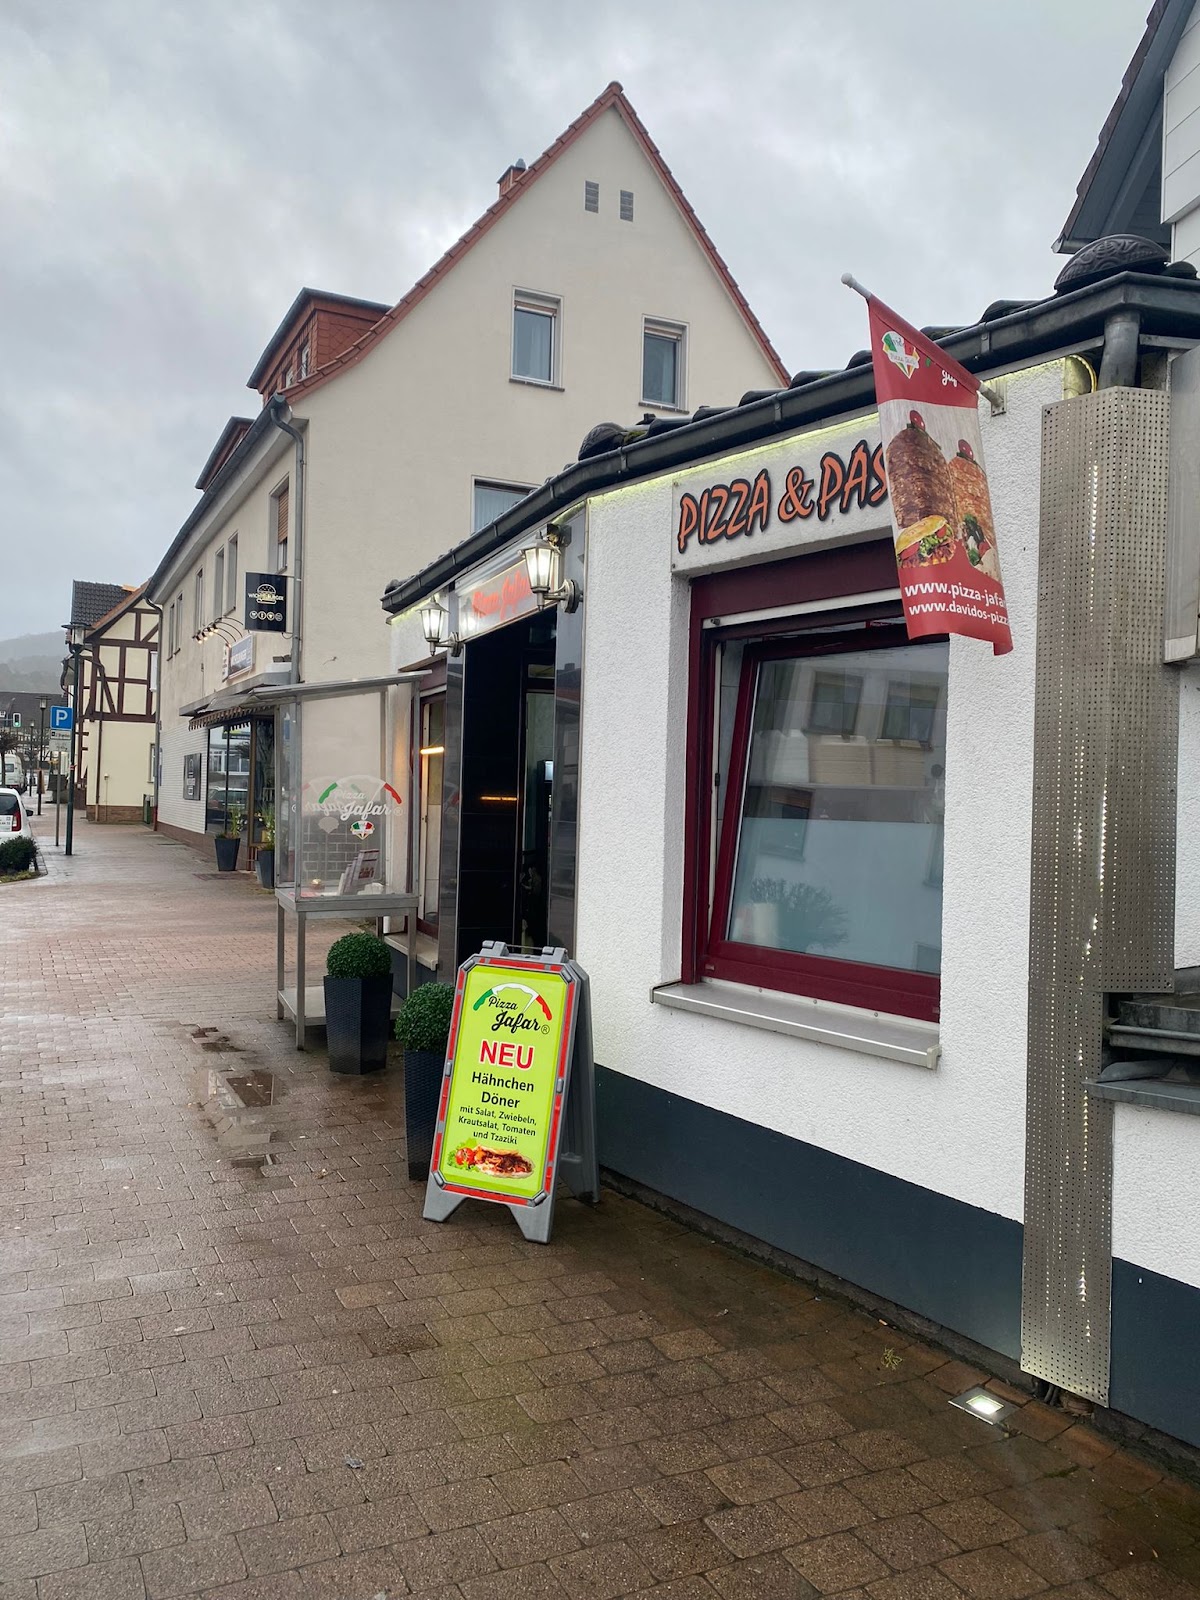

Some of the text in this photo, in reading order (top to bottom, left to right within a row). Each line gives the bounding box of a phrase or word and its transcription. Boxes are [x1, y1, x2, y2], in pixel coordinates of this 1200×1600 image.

[678, 468, 771, 553] PIZZA
[778, 465, 814, 523] &
[55, 709, 68, 726] P
[340, 800, 392, 821] Jafar
[488, 996, 518, 1010] Pizza
[480, 1040, 534, 1069] NEU
[472, 1071, 535, 1092] Hähnchen
[481, 1091, 520, 1108] Döner
[458, 1116, 536, 1136] Krautsalat, Tomaten
[460, 1106, 537, 1126] mit Salat, Zwiebeln,
[473, 1131, 518, 1145] und Tzaziki
